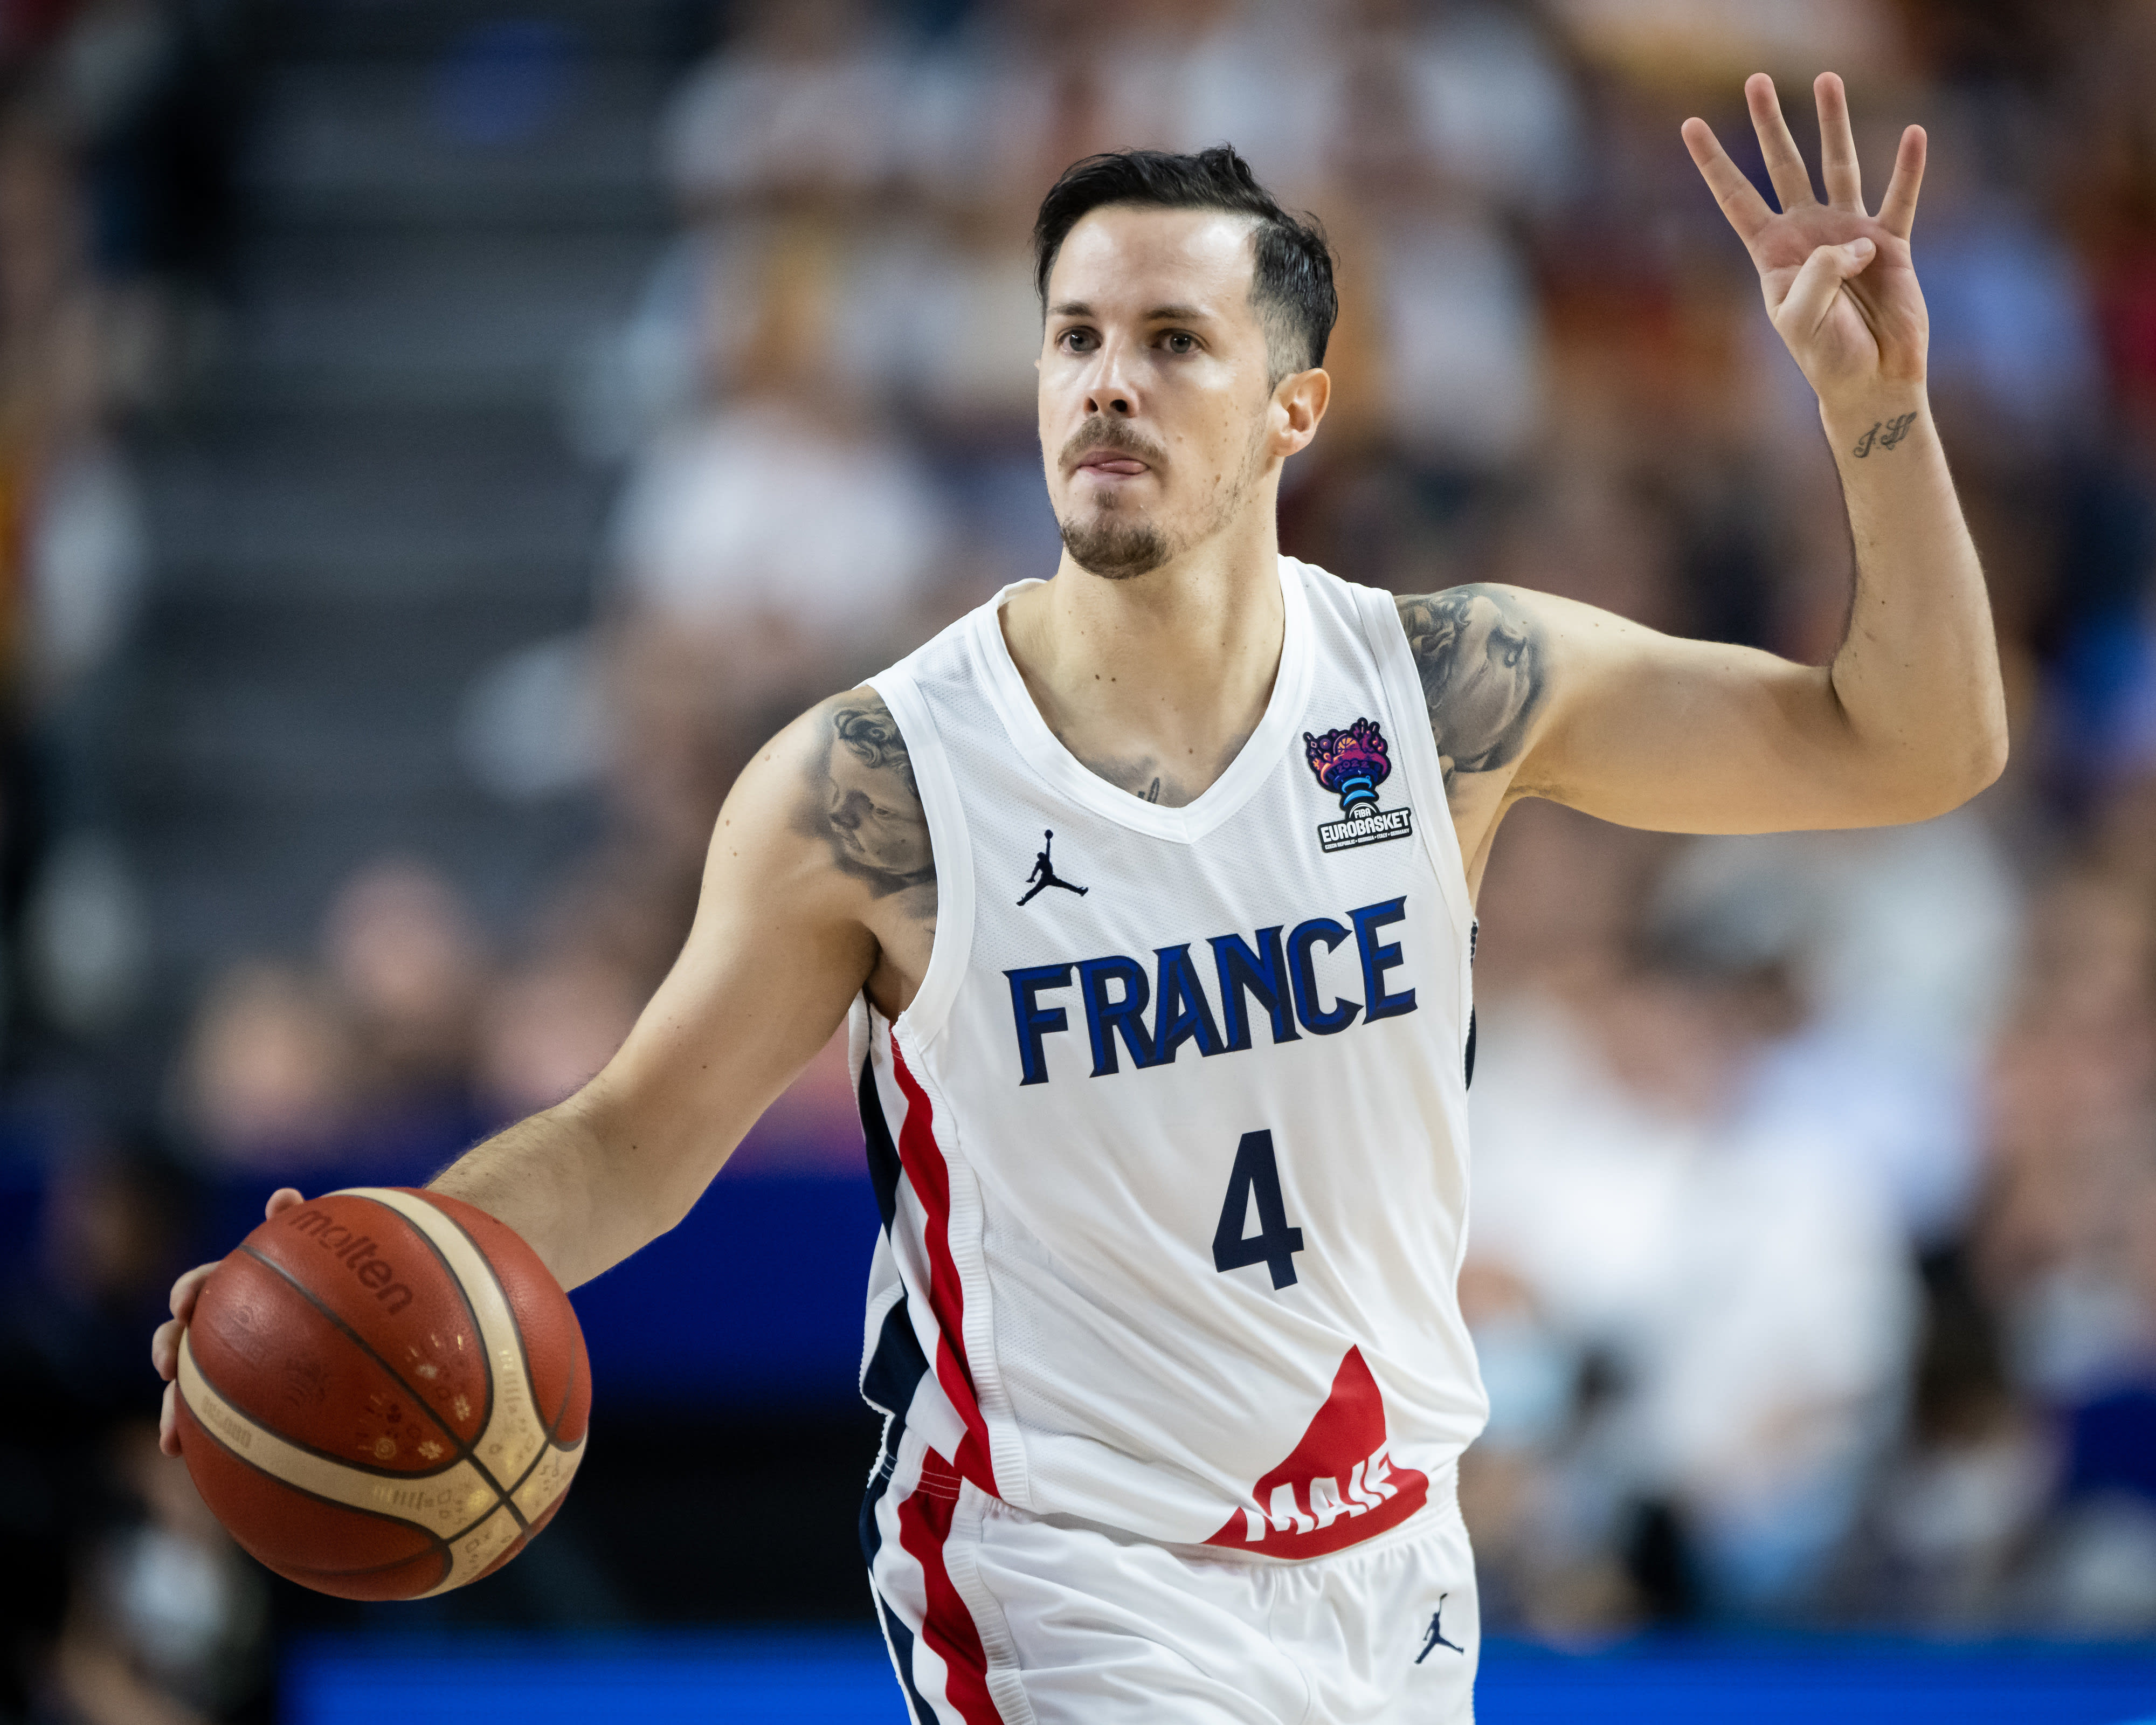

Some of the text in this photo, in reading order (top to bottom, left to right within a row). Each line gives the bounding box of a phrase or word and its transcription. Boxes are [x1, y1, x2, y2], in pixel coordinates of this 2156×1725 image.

[1337, 760, 1369, 773] 2022
[1353, 808, 1371, 819] FIBA
[1321, 810, 1409, 843] EUROBASKET
[1002, 895, 1418, 1086] FRANCE
[1212, 1129, 1304, 1290] 4
[288, 1210, 413, 1316] molten
[1245, 1440, 1398, 1542] MAIF
